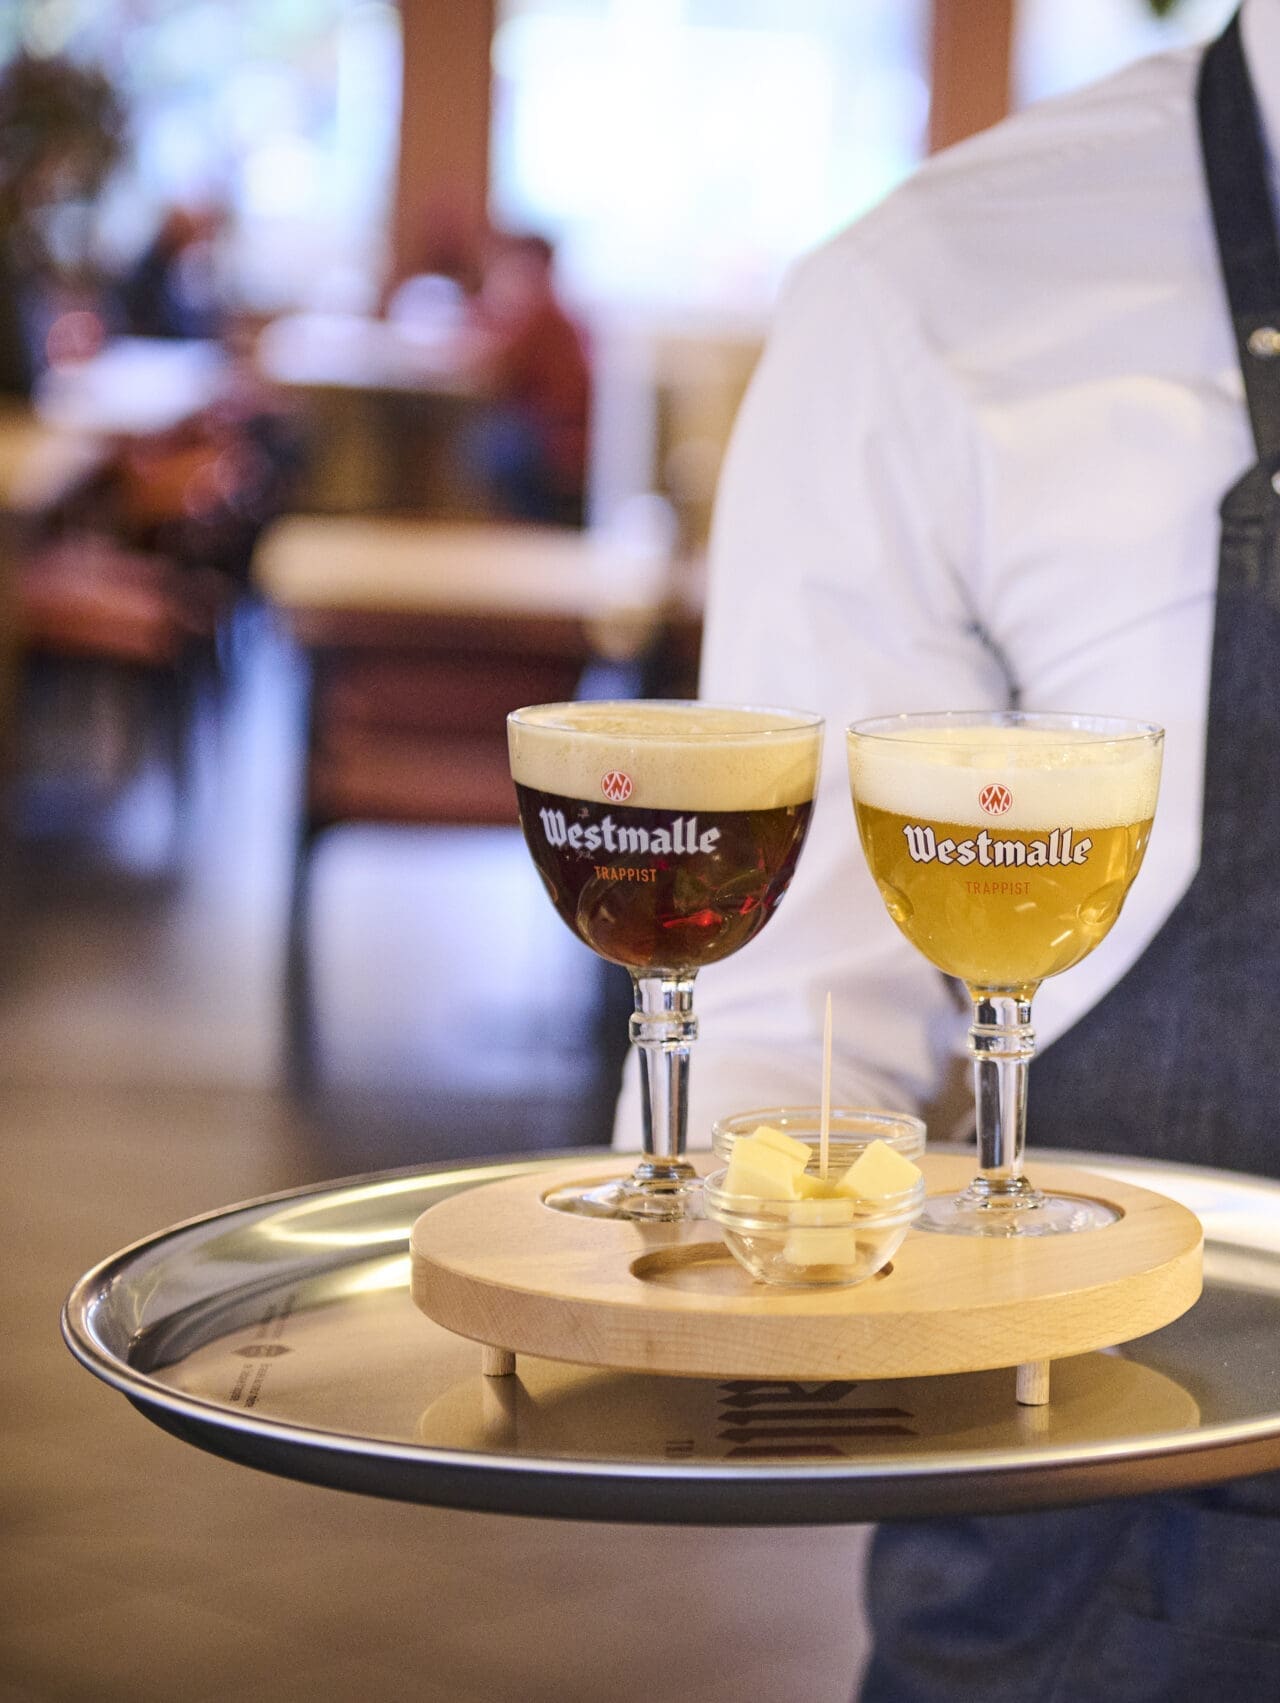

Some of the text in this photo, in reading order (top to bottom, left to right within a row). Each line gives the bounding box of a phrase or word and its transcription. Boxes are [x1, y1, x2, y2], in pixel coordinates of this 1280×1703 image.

[539, 807, 721, 855] Westmalle
[903, 824, 1093, 868] Westmalle
[594, 866, 656, 882] TRAPPIST
[966, 881, 1030, 896] TRAPPIST
